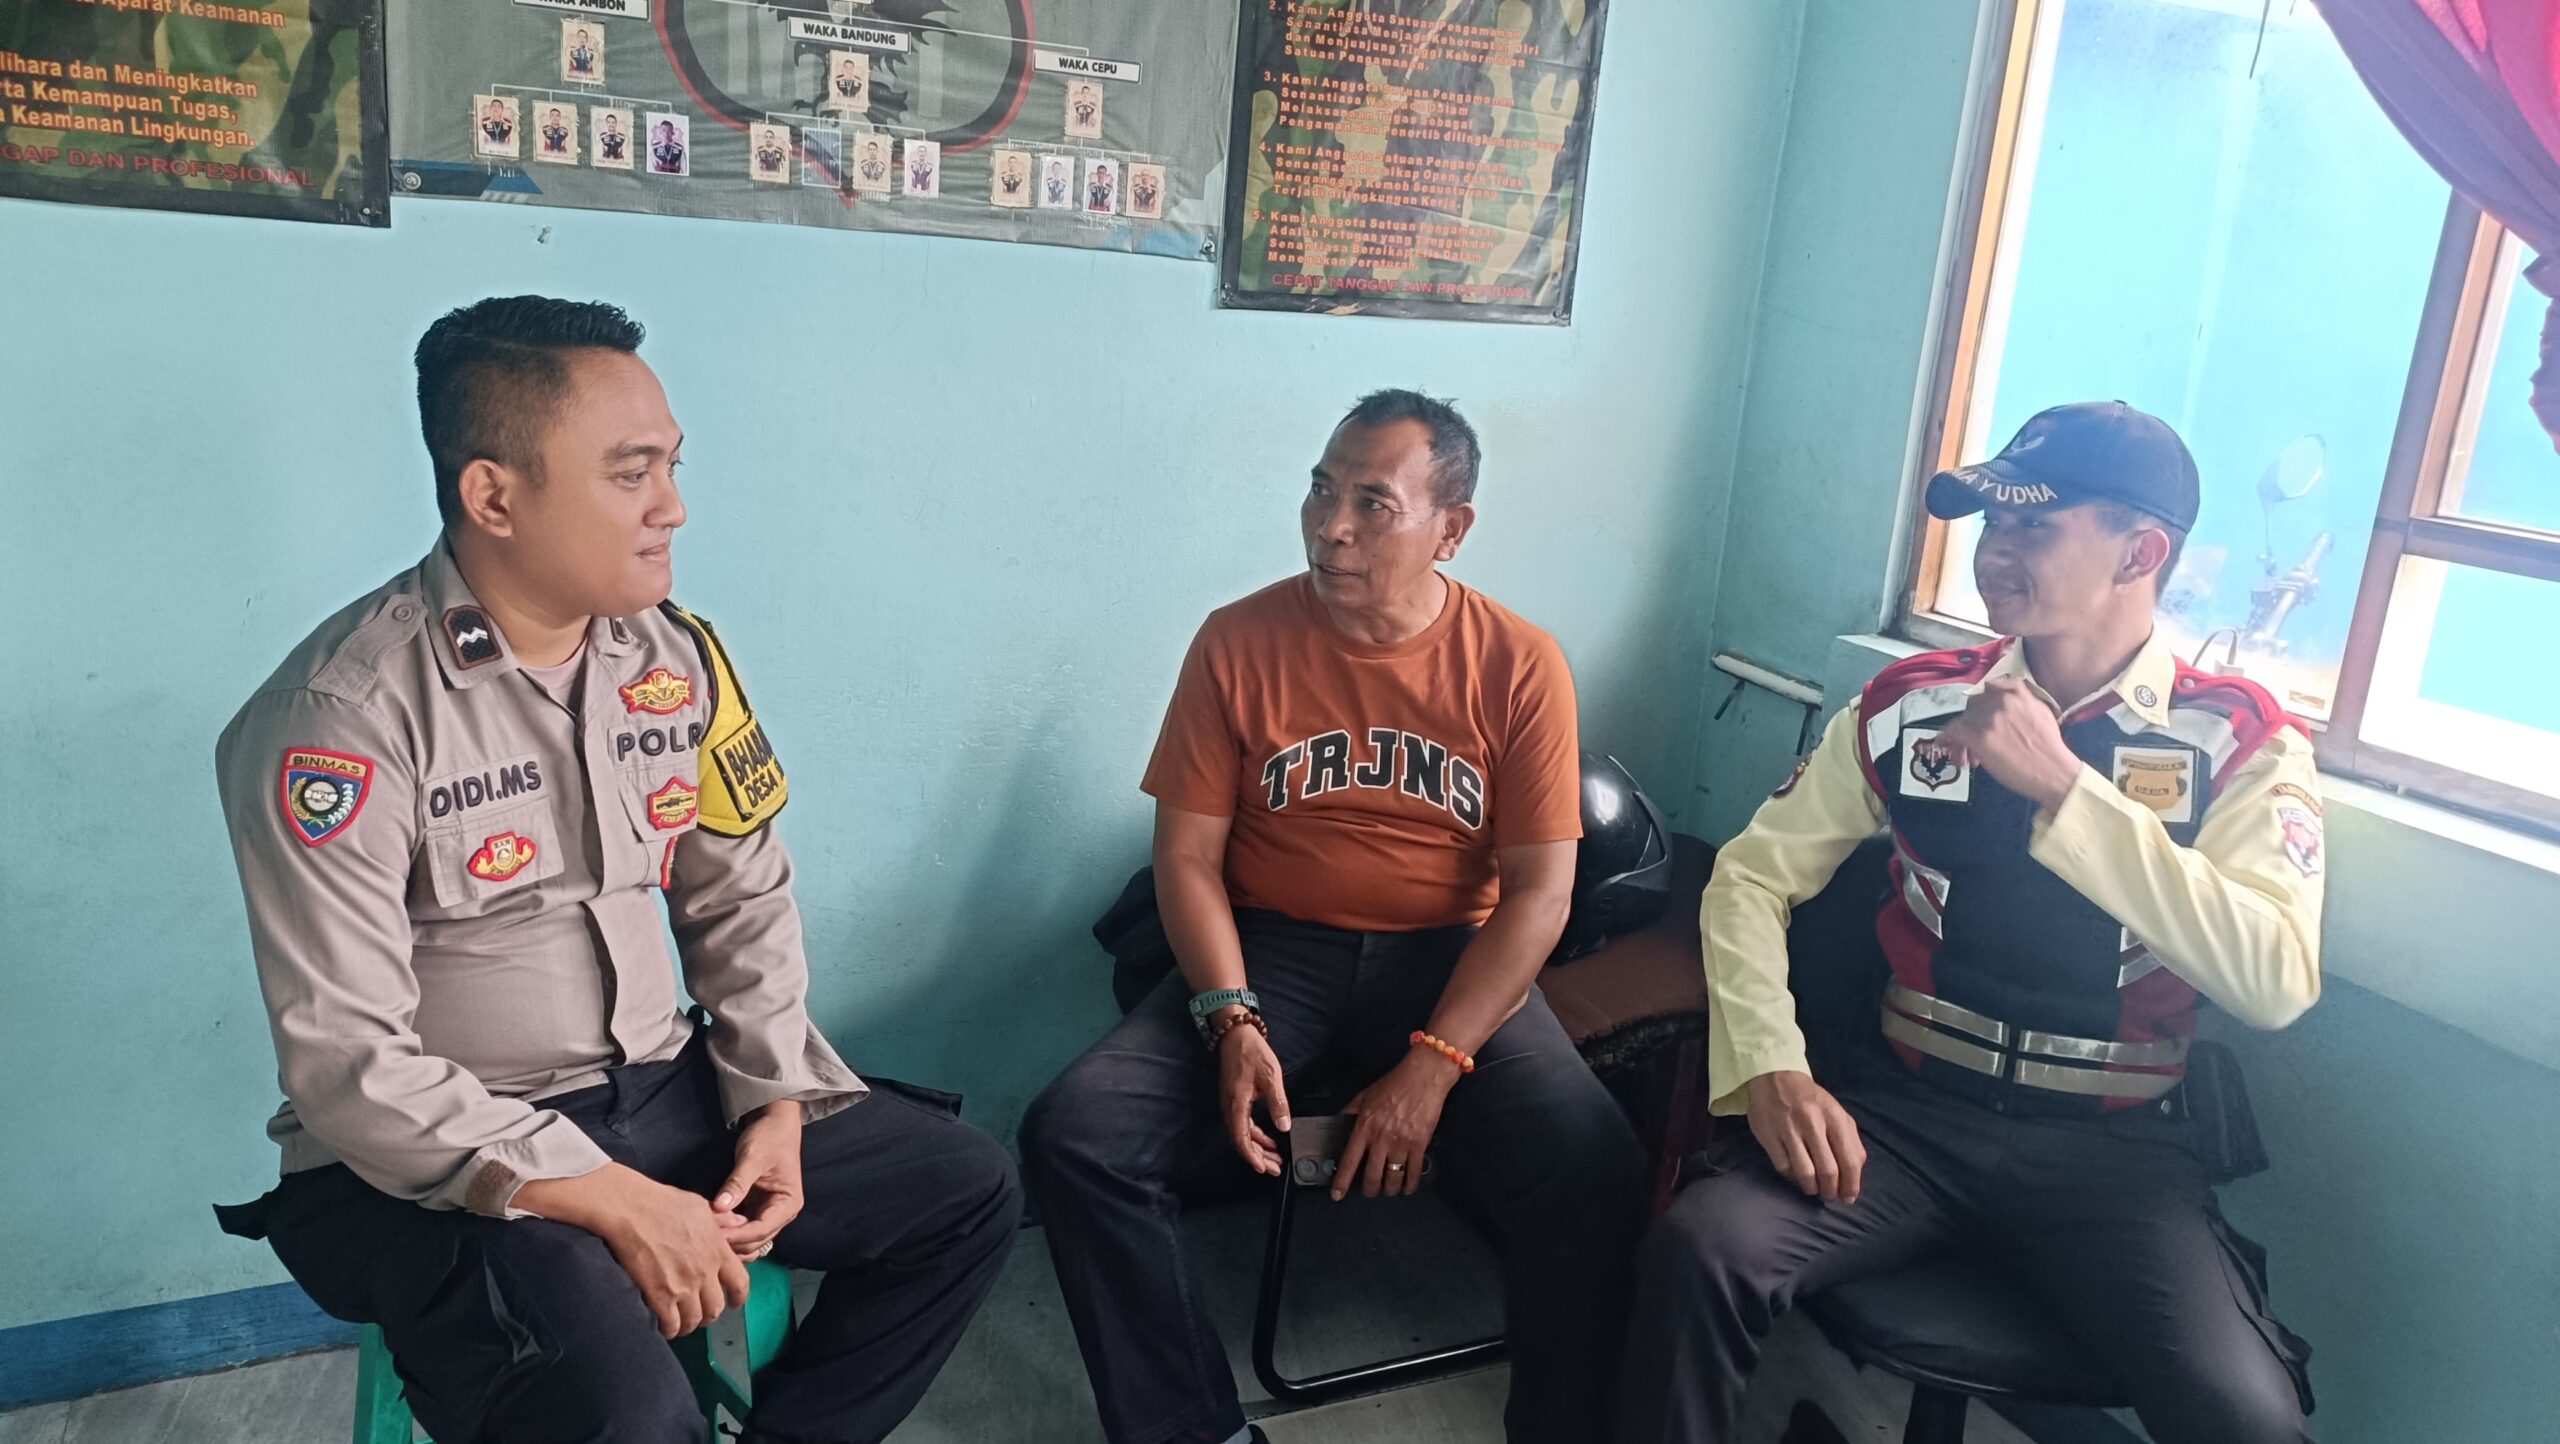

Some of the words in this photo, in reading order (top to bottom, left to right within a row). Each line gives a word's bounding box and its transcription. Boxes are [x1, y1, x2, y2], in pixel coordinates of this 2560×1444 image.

[180, 0, 285, 27] Keamanan
[1287, 3, 1323, 15] Kami
[1328, 8, 1385, 22] Anggota
[1389, 14, 1436, 29] Satuan
[804, 23, 837, 38] WAKA
[841, 28, 896, 45] BANDUNG
[1286, 17, 1368, 35] Senantiasa
[1284, 45, 1335, 60] Satuan
[1285, 32, 1310, 43] dan
[1316, 34, 1396, 55] Menjunjung
[1400, 44, 1442, 60] Tinggi
[1059, 57, 1089, 71] WAKA
[1092, 62, 1118, 74] CEPU
[69, 59, 107, 81] dan
[115, 64, 258, 97] Meningkatkan
[1282, 73, 1317, 86] Kami
[1321, 78, 1378, 93] Anggota
[32, 81, 162, 112] Kemampuan
[169, 95, 238, 124] Tugas,
[1282, 87, 1361, 105] Senantiasa
[12, 104, 123, 133] Keamanan
[131, 116, 256, 147] Lingkungan.
[1276, 143, 1312, 156] Kami
[69, 150, 125, 169] DAN
[134, 156, 316, 187] PROFESIONAL
[1270, 211, 1305, 223] Kami
[1370, 218, 1416, 231] Satuan
[1381, 234, 1412, 245] yang
[1272, 273, 1323, 288] CEPAT
[293, 755, 360, 775] BINMAS
[744, 767, 779, 808] DESA
[1260, 727, 1484, 830] TRJNS
